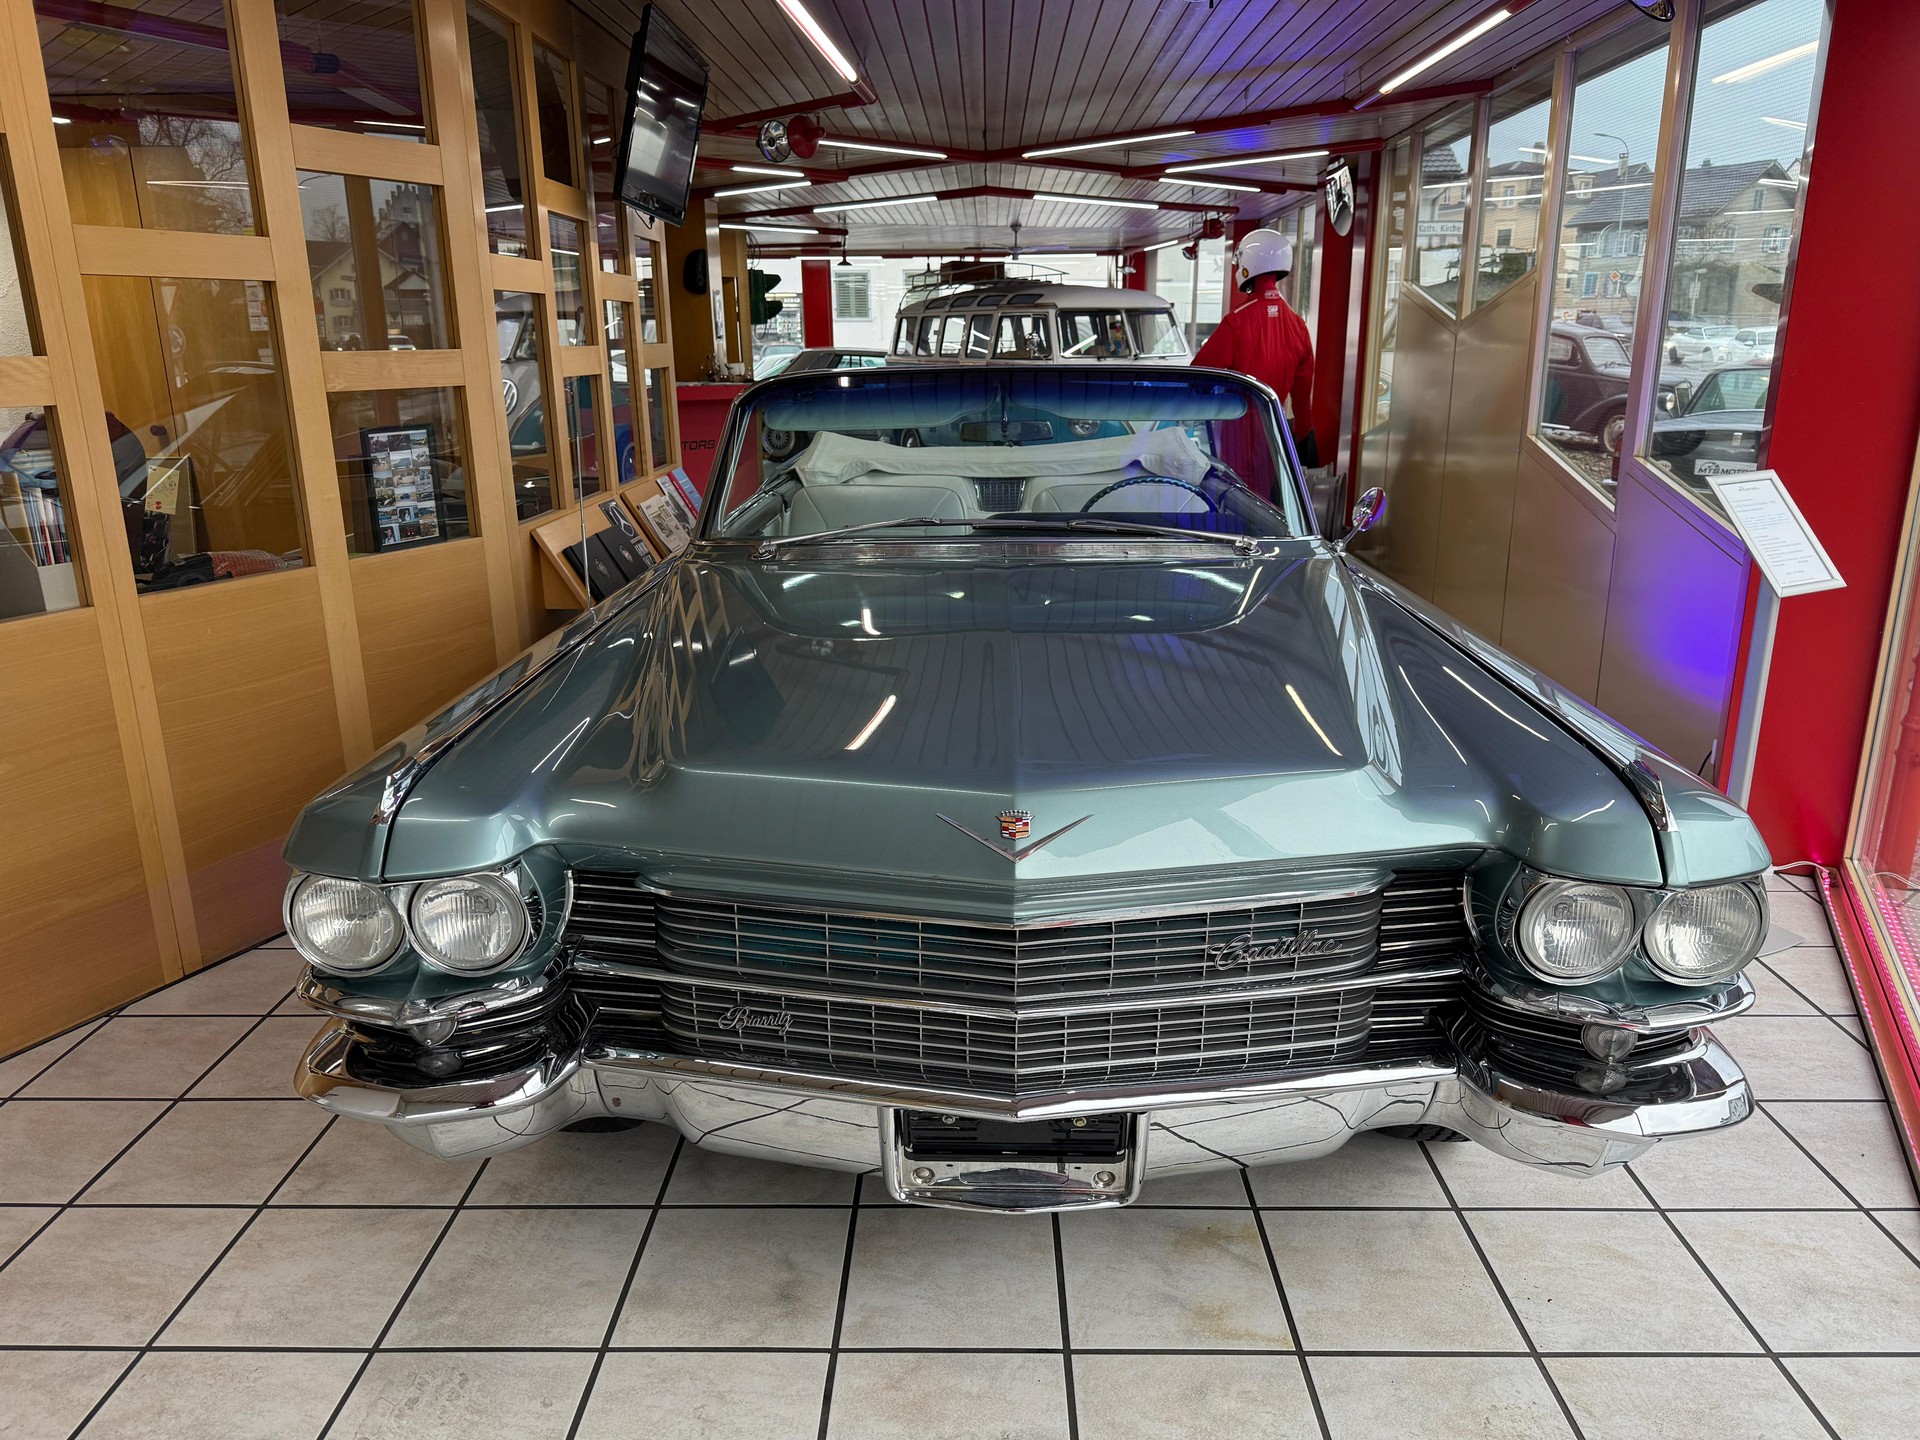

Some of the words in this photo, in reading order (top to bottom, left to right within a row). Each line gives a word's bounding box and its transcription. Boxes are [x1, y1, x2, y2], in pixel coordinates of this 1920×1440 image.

[1418, 224, 1438, 233] Kath.
[1440, 224, 1462, 233] Kirche
[681, 439, 716, 451] TORS
[1207, 928, 1343, 971] Cadillac
[718, 1005, 793, 1035] Biarritz
